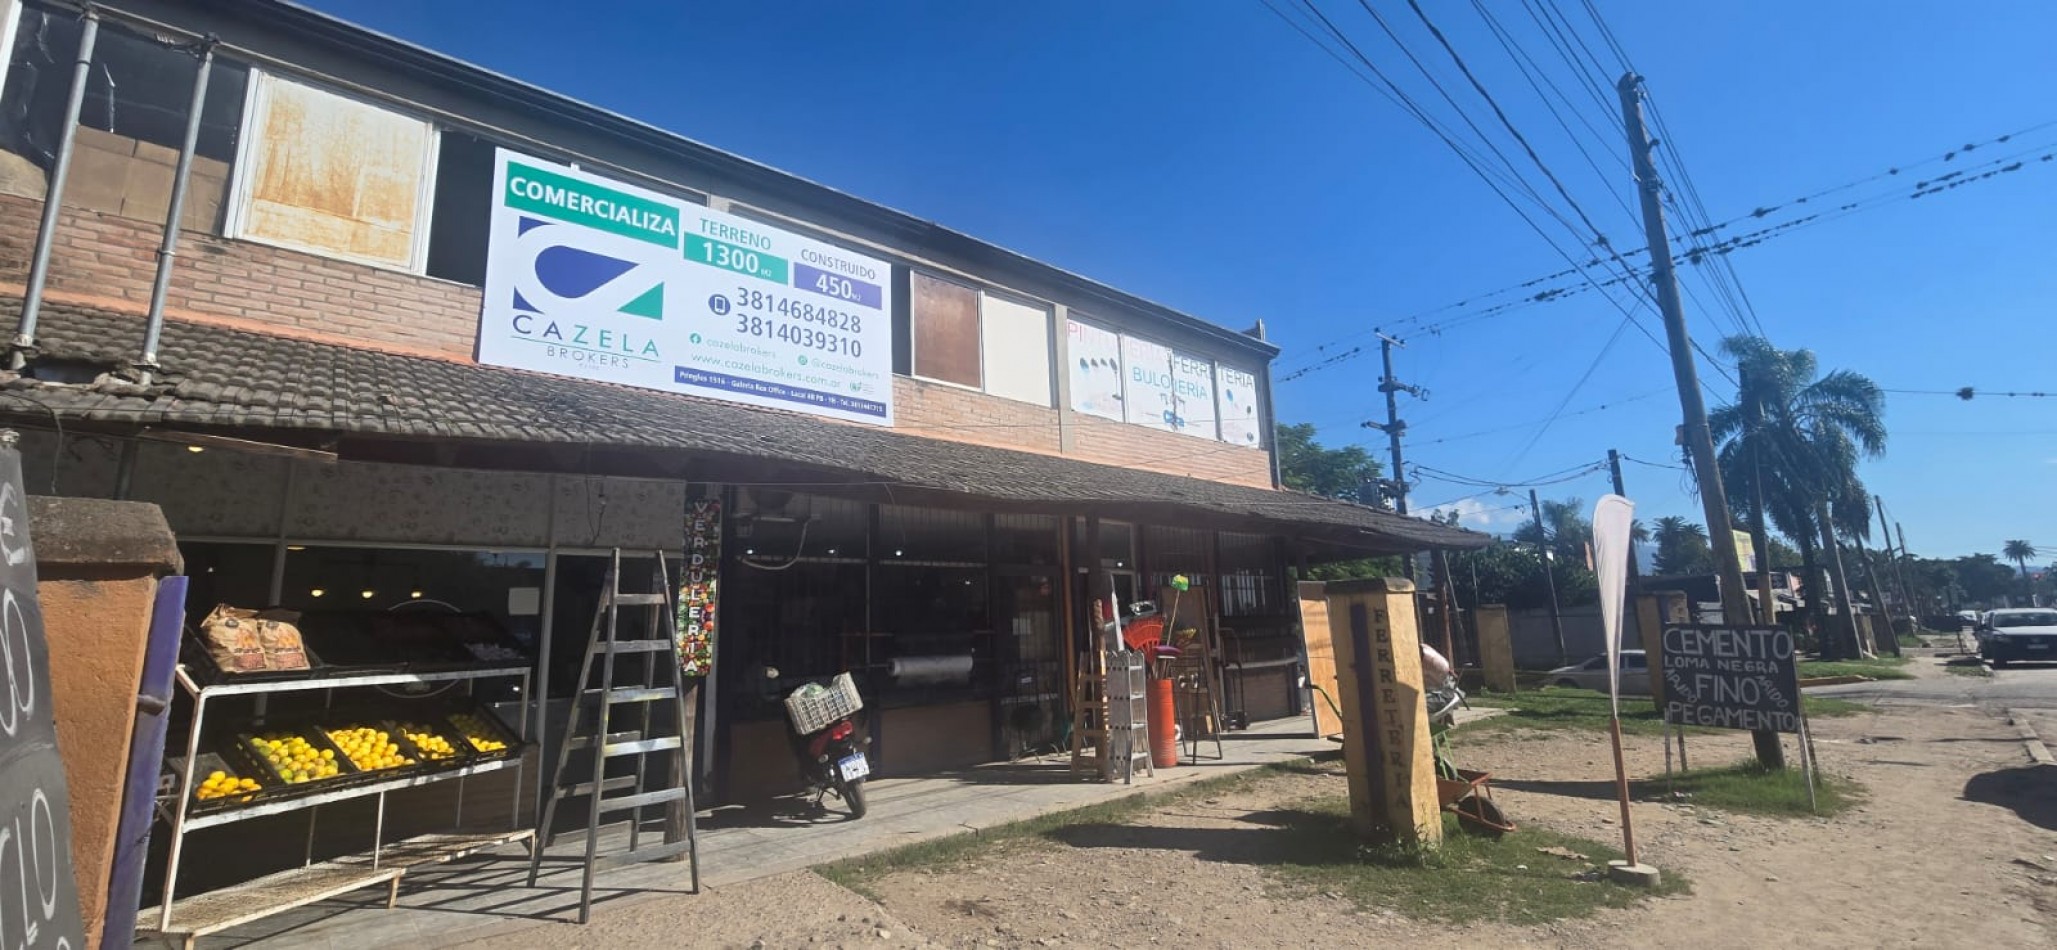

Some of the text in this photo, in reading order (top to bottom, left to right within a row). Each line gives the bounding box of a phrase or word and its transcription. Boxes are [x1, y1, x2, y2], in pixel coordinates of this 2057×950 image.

[510, 176, 676, 236] COMERCIALIZA
[700, 217, 771, 250] TERRENO
[703, 241, 759, 273] 1300
[800, 248, 876, 280] CONSTRUIDO
[816, 274, 852, 299] 450
[737, 287, 861, 333] 3814684828
[512, 314, 659, 357] CAZELA
[737, 313, 861, 357] 3814039310
[547, 345, 629, 368] BROKERS
[690, 352, 841, 388] www.cazelabrokers.com.ar
[684, 502, 707, 672] VERDULERIA
[1664, 627, 1792, 660] CEMENTO
[1664, 655, 1779, 674] LOMA NEGRA
[1695, 673, 1760, 705] FINO
[1373, 608, 1409, 808] FERRETERIA
[1668, 701, 1796, 731] PEGAMENTO
